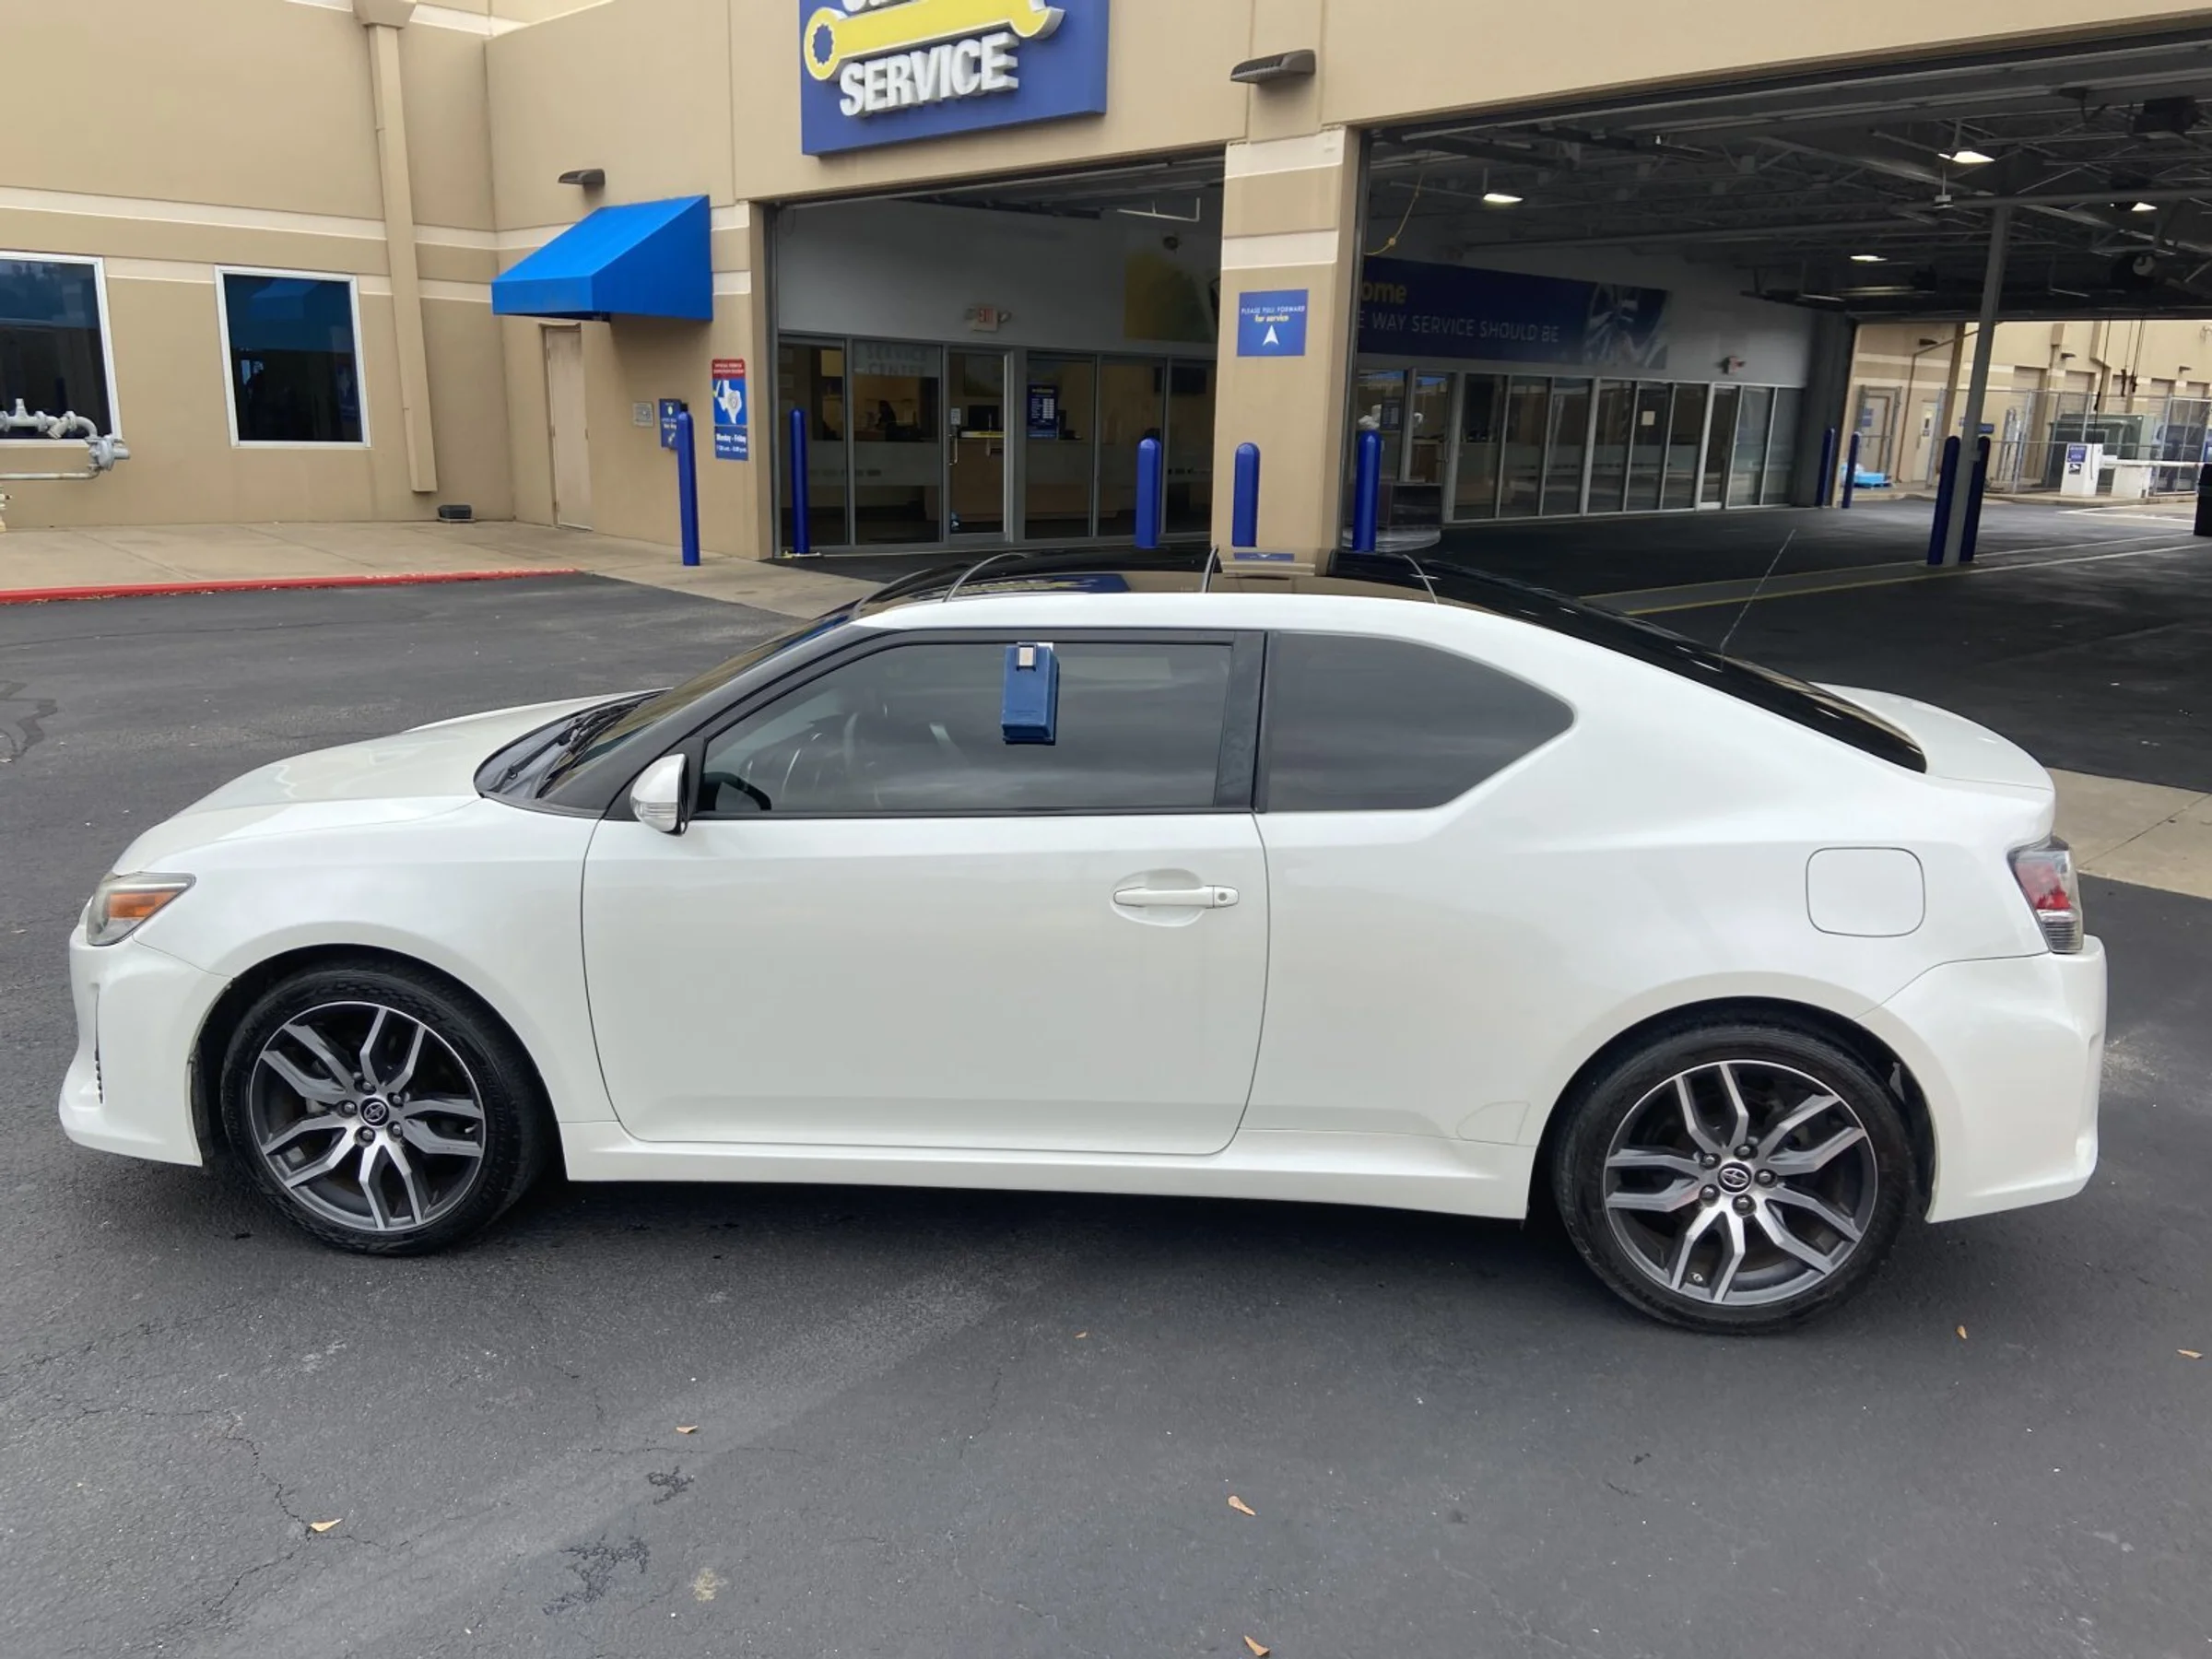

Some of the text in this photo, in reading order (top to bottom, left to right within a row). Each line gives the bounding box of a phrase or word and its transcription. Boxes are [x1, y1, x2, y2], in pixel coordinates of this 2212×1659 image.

[840, 32, 1018, 117] SERVICE
[1372, 312, 1406, 333] WAY
[1411, 315, 1476, 337] SERVICE
[1479, 321, 1538, 342] SHOULD
[1541, 325, 1559, 344] BE
